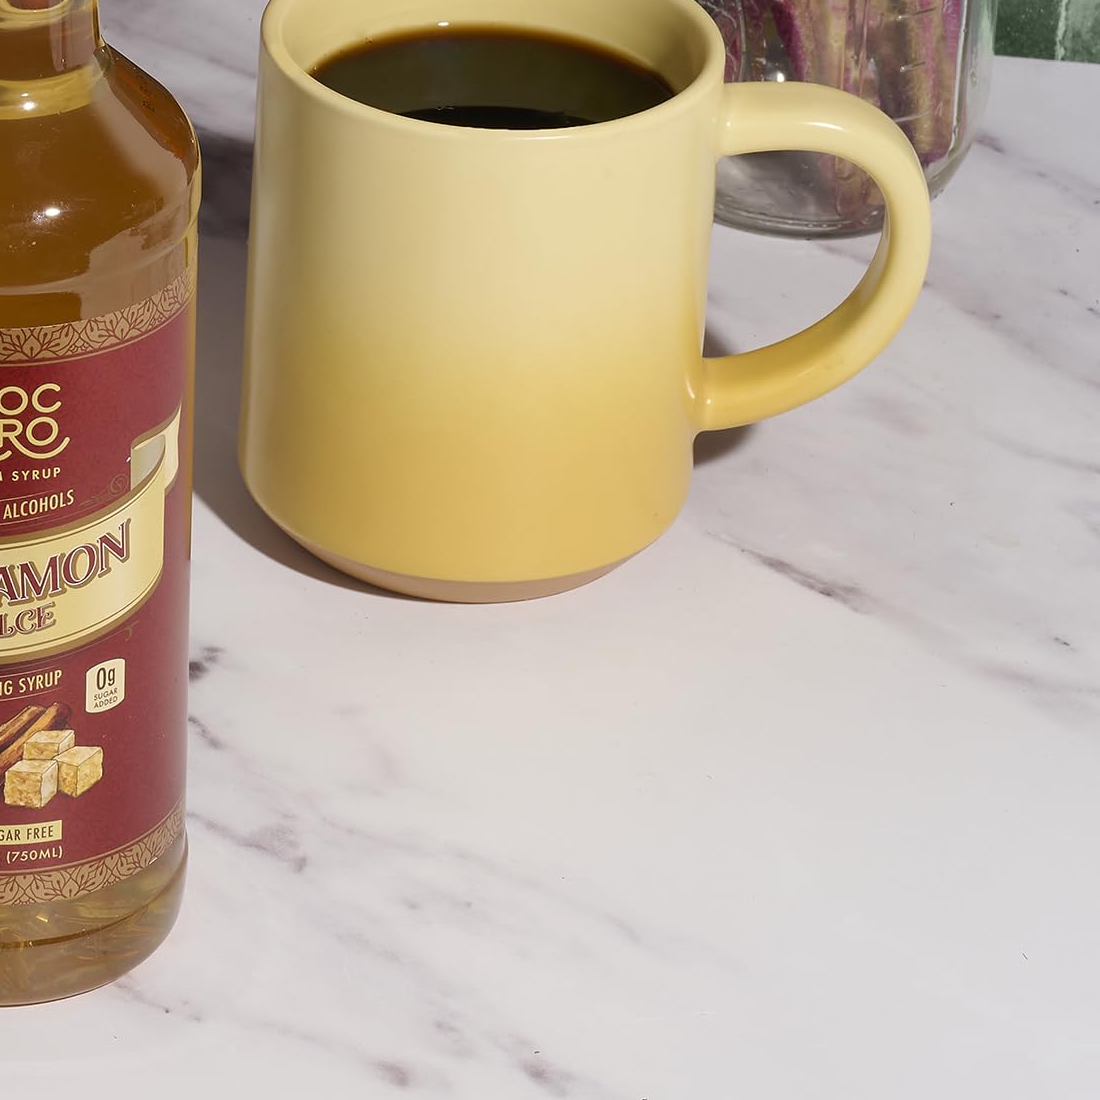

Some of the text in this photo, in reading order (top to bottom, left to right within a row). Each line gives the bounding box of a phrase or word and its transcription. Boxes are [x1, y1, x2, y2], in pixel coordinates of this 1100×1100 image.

[11, 467, 61, 482] SYRUP
[3, 489, 75, 520] ALCOHOLS
[19, 669, 63, 693] SYRUP
[96, 667, 116, 690] 0g
[93, 687, 118, 701] SUGAR
[93, 696, 118, 709] ADDED
[26, 825, 54, 840] FREE
[6, 845, 63, 864] (750ML)
